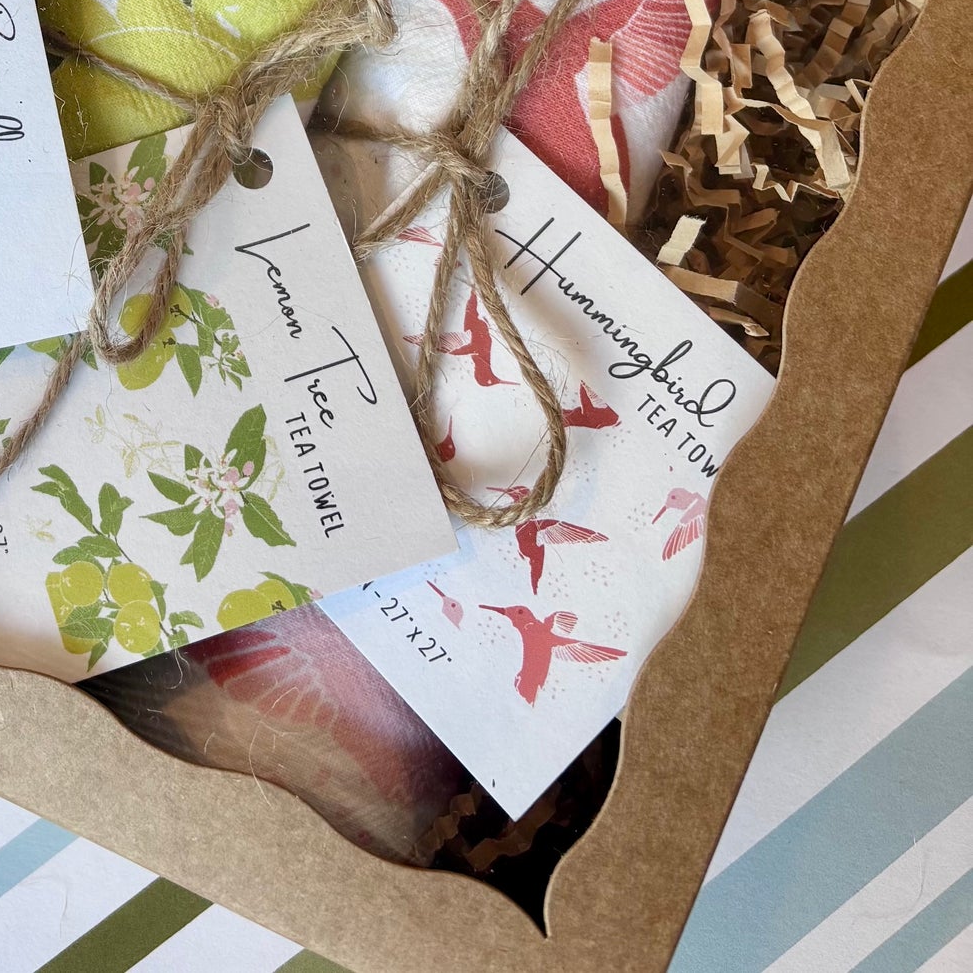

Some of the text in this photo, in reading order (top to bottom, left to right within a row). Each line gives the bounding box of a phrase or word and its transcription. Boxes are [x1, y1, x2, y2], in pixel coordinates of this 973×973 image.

[234, 223, 378, 429] Lemon Tree
[494, 217, 737, 428] Hummingbird
[285, 411, 345, 539] TEA TOWEL
[637, 393, 723, 478] TEA TOW
